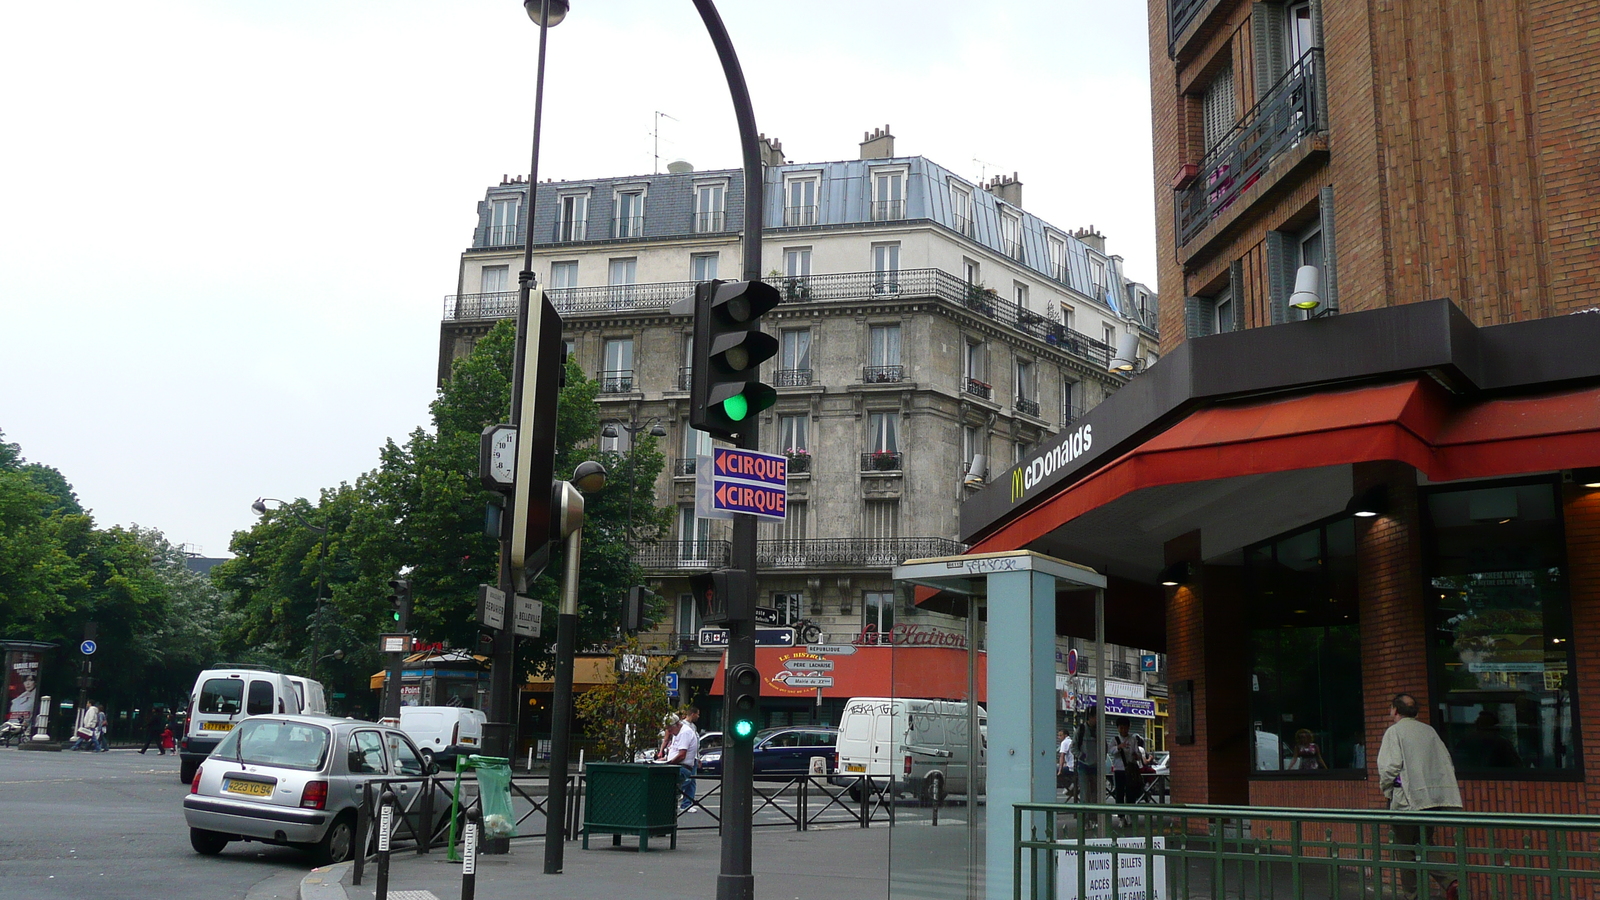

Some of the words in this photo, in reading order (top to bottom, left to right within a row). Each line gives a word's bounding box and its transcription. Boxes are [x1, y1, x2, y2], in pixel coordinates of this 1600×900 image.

[726, 454, 784, 480] CIRQUE
[1011, 423, 1092, 503] McDonald's
[726, 486, 784, 512] CIRQUE
[852, 624, 879, 644] Le
[888, 624, 965, 646] Clairon
[228, 780, 248, 792] 4223
[249, 783, 259, 793] YC
[261, 785, 271, 794] 94
[1089, 859, 1110, 871] MUNIS
[1121, 857, 1142, 868] BILLETS
[1090, 877, 1110, 890] ACCÈS
[1119, 876, 1141, 888] INCIPAL
